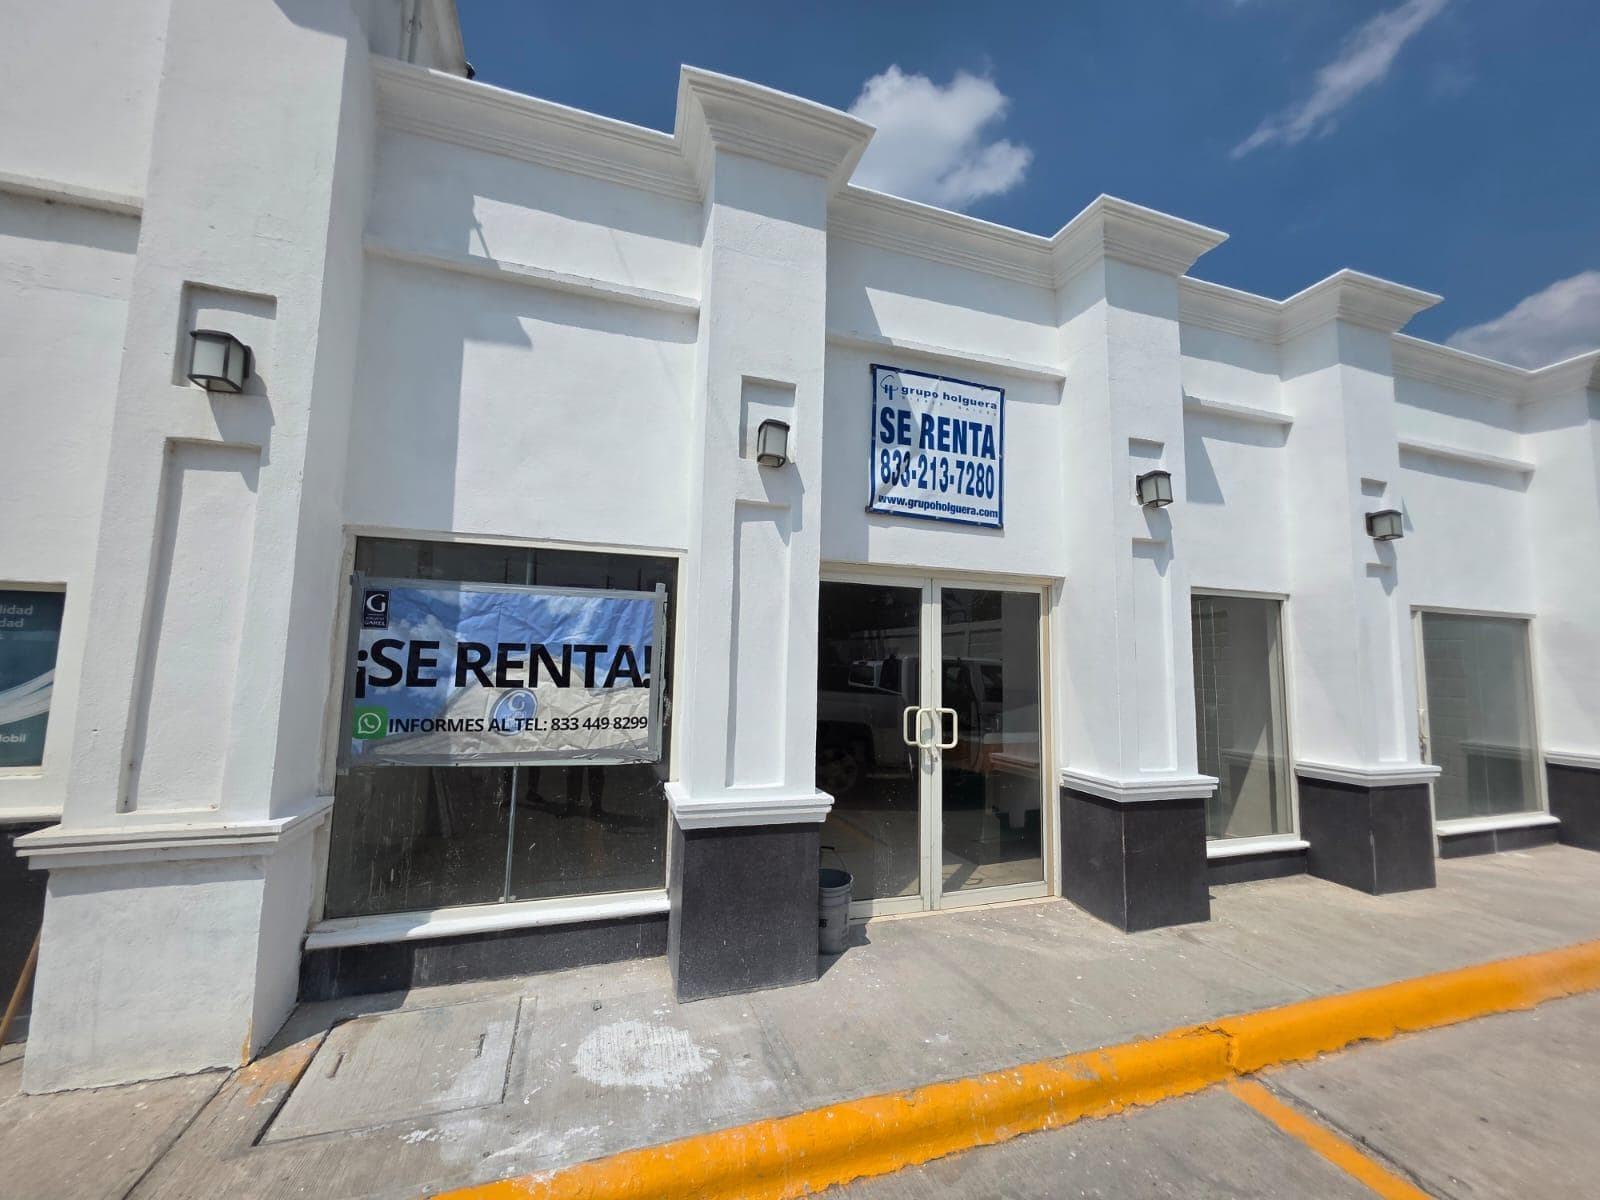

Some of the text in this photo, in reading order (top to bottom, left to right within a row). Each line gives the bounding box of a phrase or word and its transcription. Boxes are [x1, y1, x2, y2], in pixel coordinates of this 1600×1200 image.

[901, 386, 939, 399] grupo
[943, 392, 997, 410] holguera
[880, 407, 996, 460] SE RENTA
[880, 448, 995, 500] 833-213-7280
[878, 494, 998, 518] www.grupoholguera.com
[366, 593, 386, 613] G
[355, 638, 652, 698] ¡SE RENTA!
[389, 718, 484, 733] INFORMES
[488, 718, 511, 733] AL
[515, 718, 548, 732] TEL:
[551, 717, 579, 731] 833
[582, 717, 610, 731] 449
[613, 716, 648, 730] 8299
